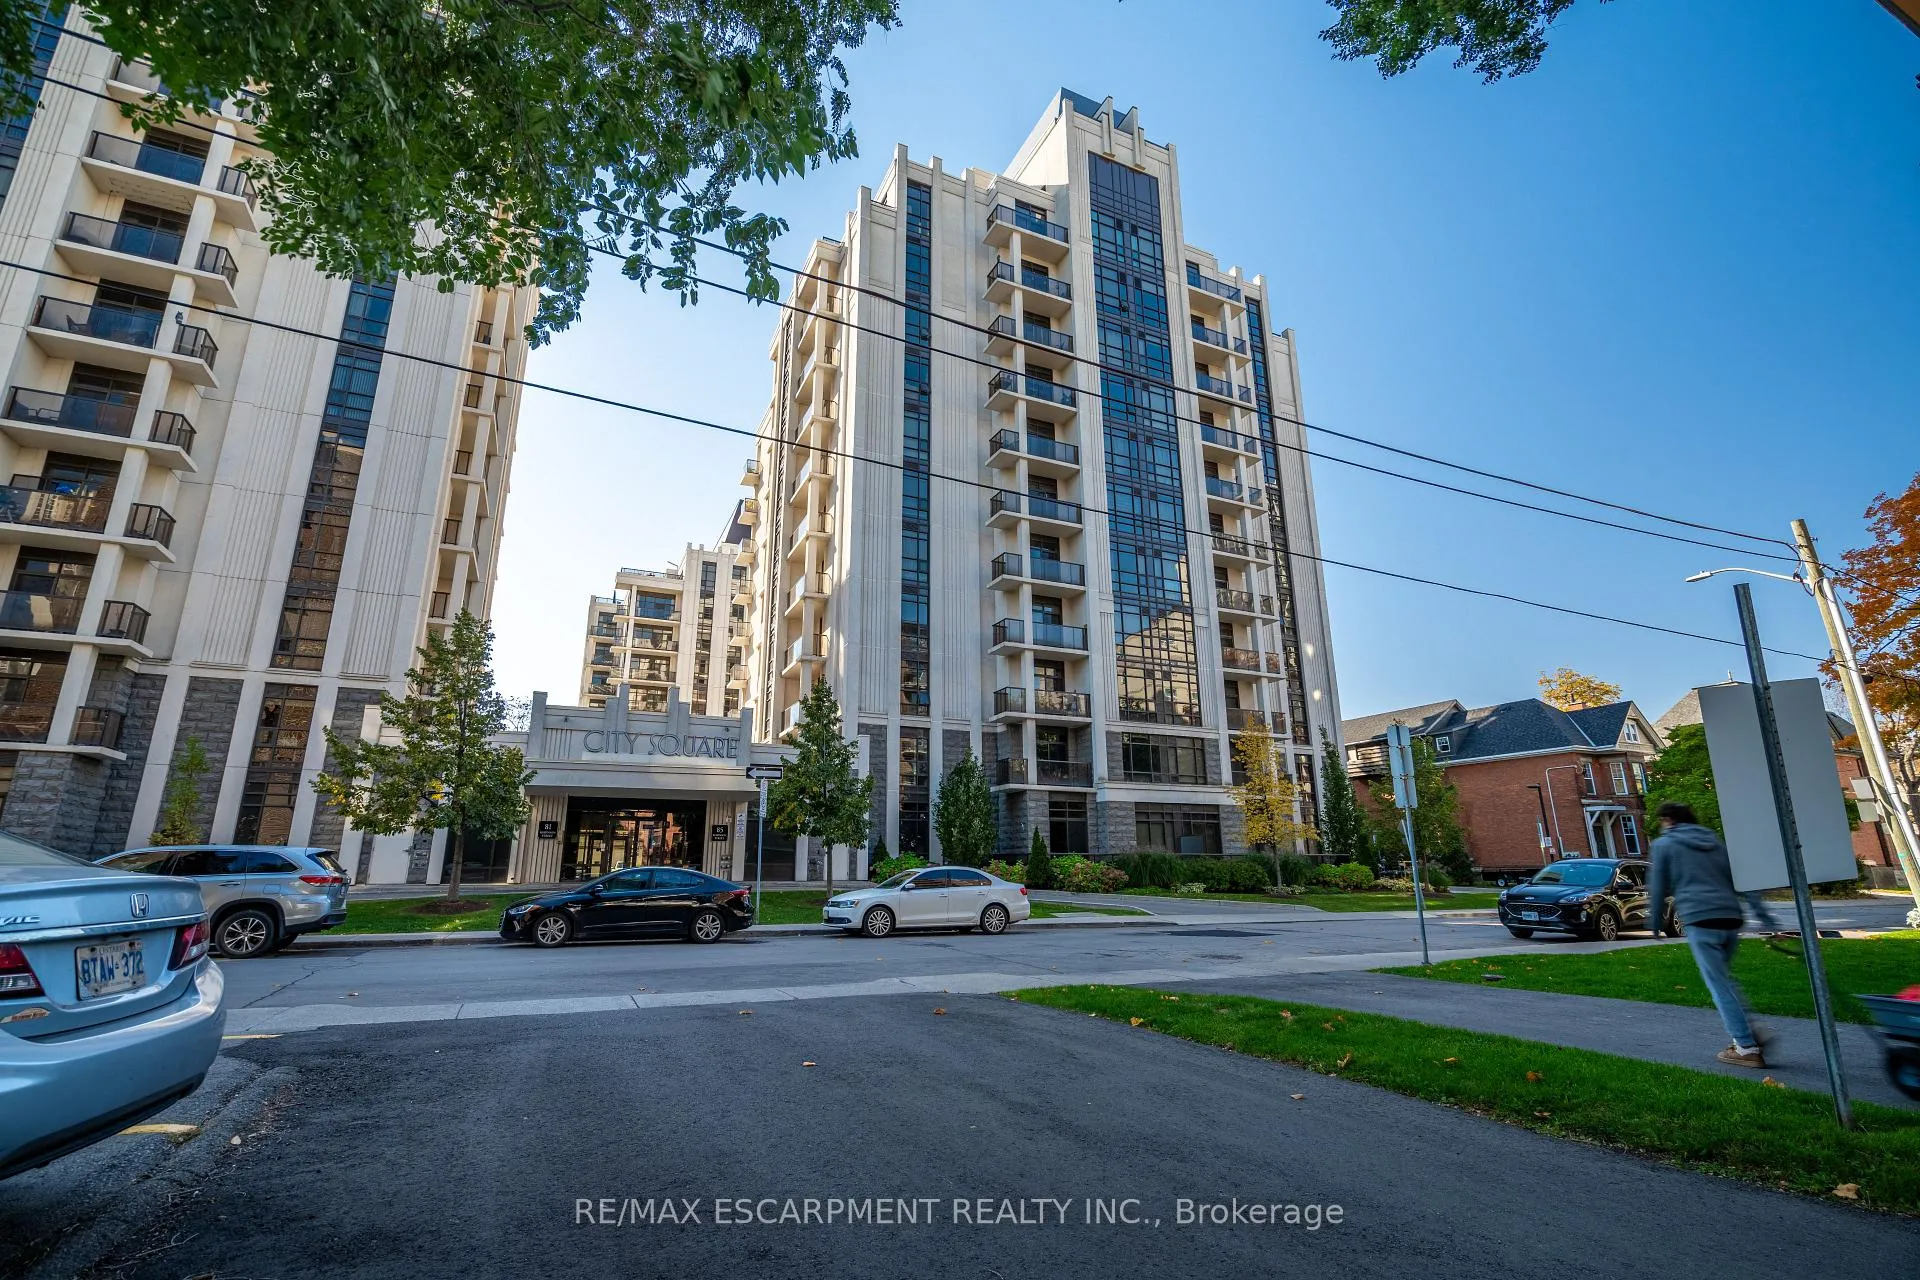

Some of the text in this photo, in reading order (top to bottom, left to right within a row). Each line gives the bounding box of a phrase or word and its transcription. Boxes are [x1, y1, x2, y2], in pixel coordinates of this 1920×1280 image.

[583, 729, 738, 759] CITY SQUARE
[716, 826, 724, 834] 85
